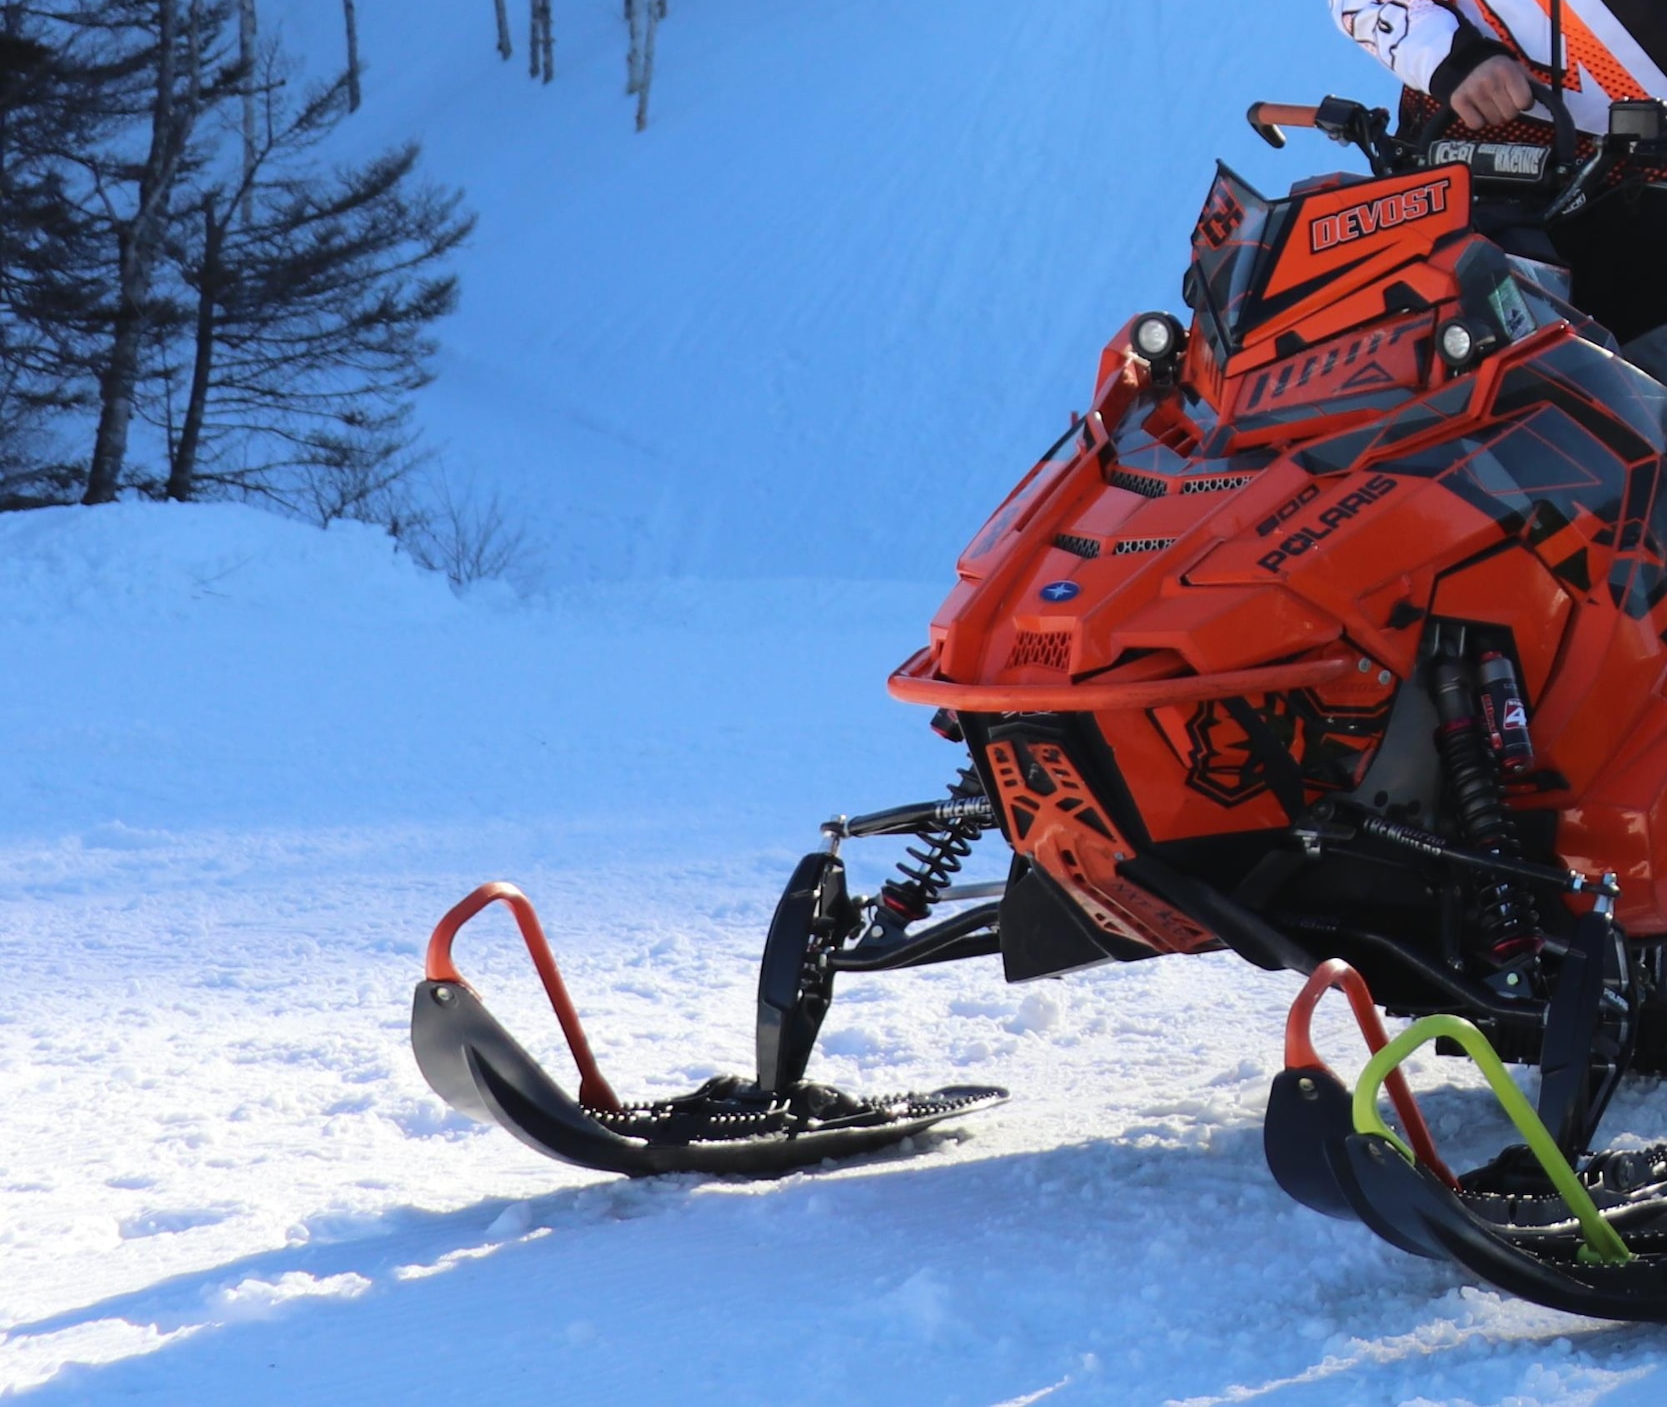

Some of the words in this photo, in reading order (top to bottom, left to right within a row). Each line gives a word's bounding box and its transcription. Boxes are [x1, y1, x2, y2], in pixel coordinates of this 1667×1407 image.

[1310, 179, 1450, 253] DEVOST
[1256, 483, 1320, 537] 800
[1257, 474, 1397, 573] POLARIS
